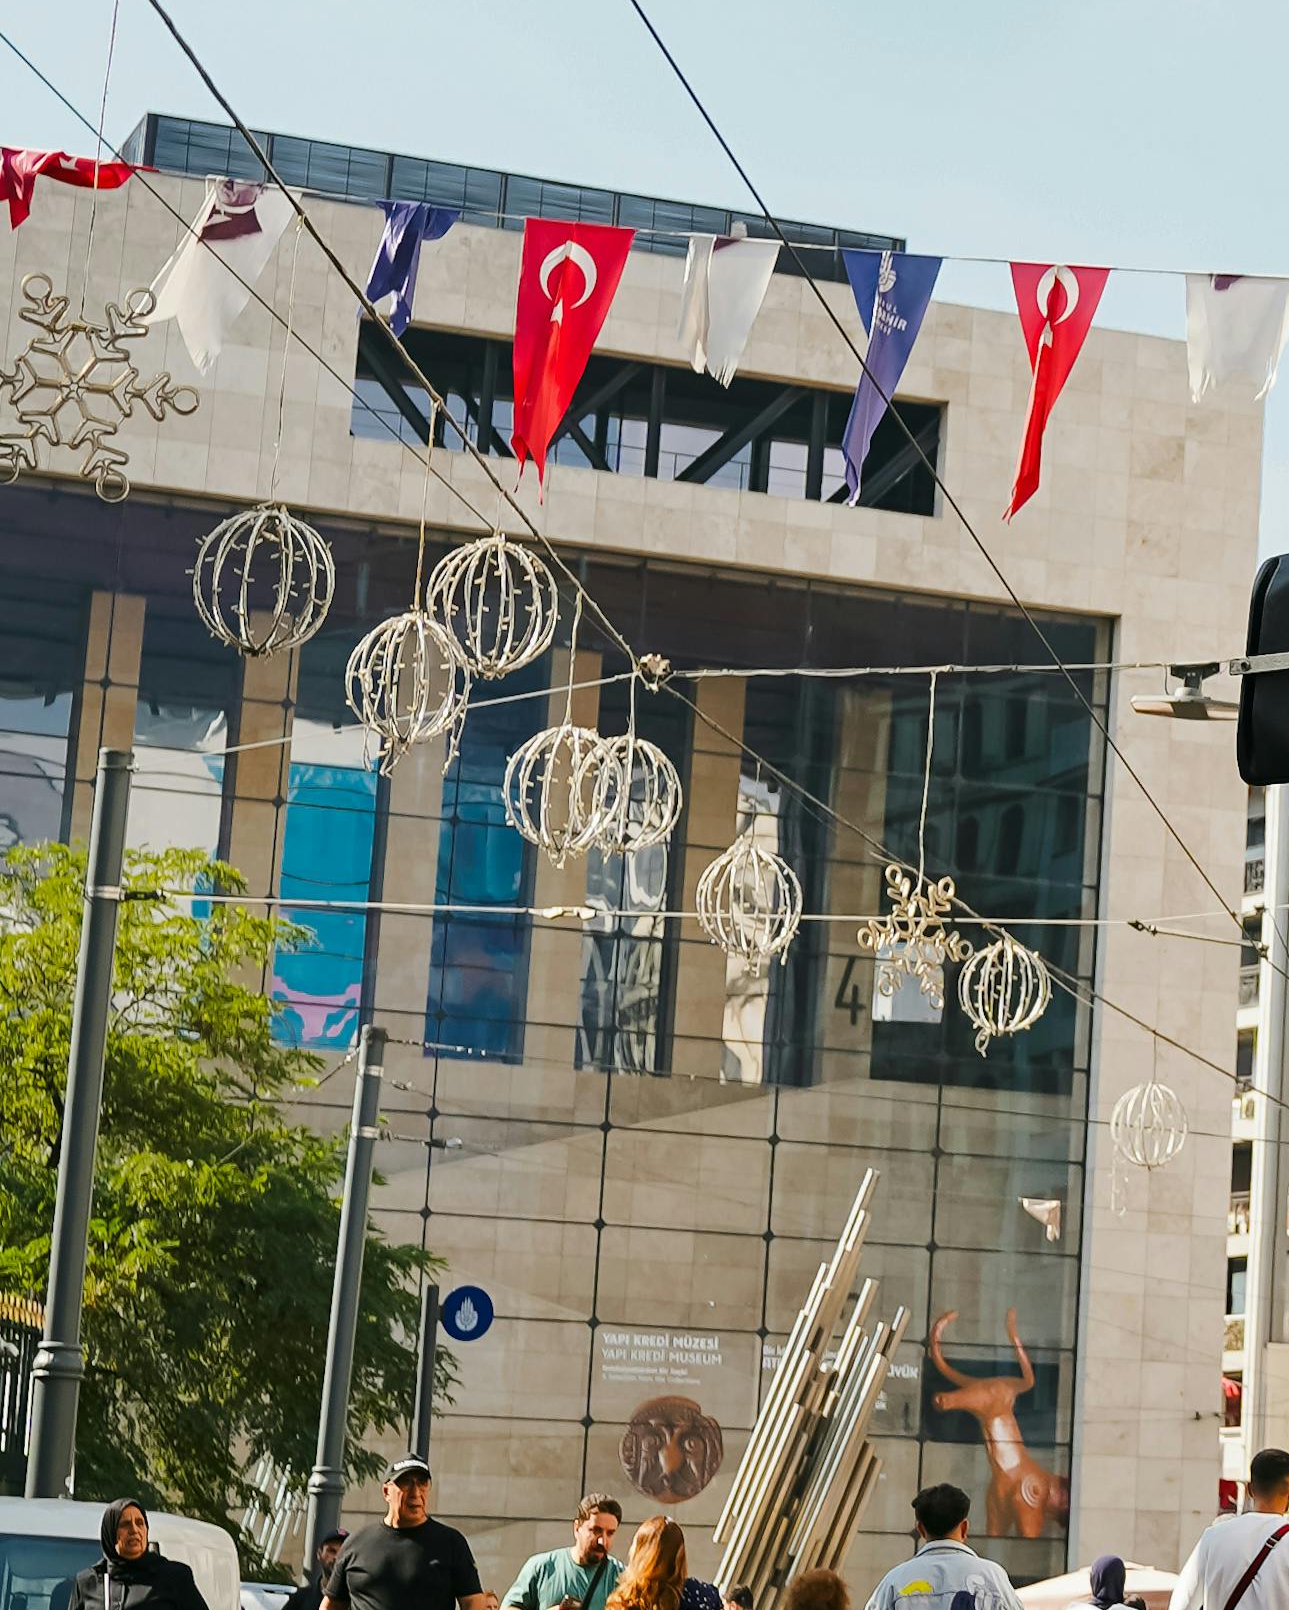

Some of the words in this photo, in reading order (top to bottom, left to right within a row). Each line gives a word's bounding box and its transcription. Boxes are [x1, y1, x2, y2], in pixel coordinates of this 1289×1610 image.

[602, 1332, 629, 1346] YAPI
[602, 1348, 627, 1361] YAPI
[668, 1352, 722, 1365] MUSEUM
